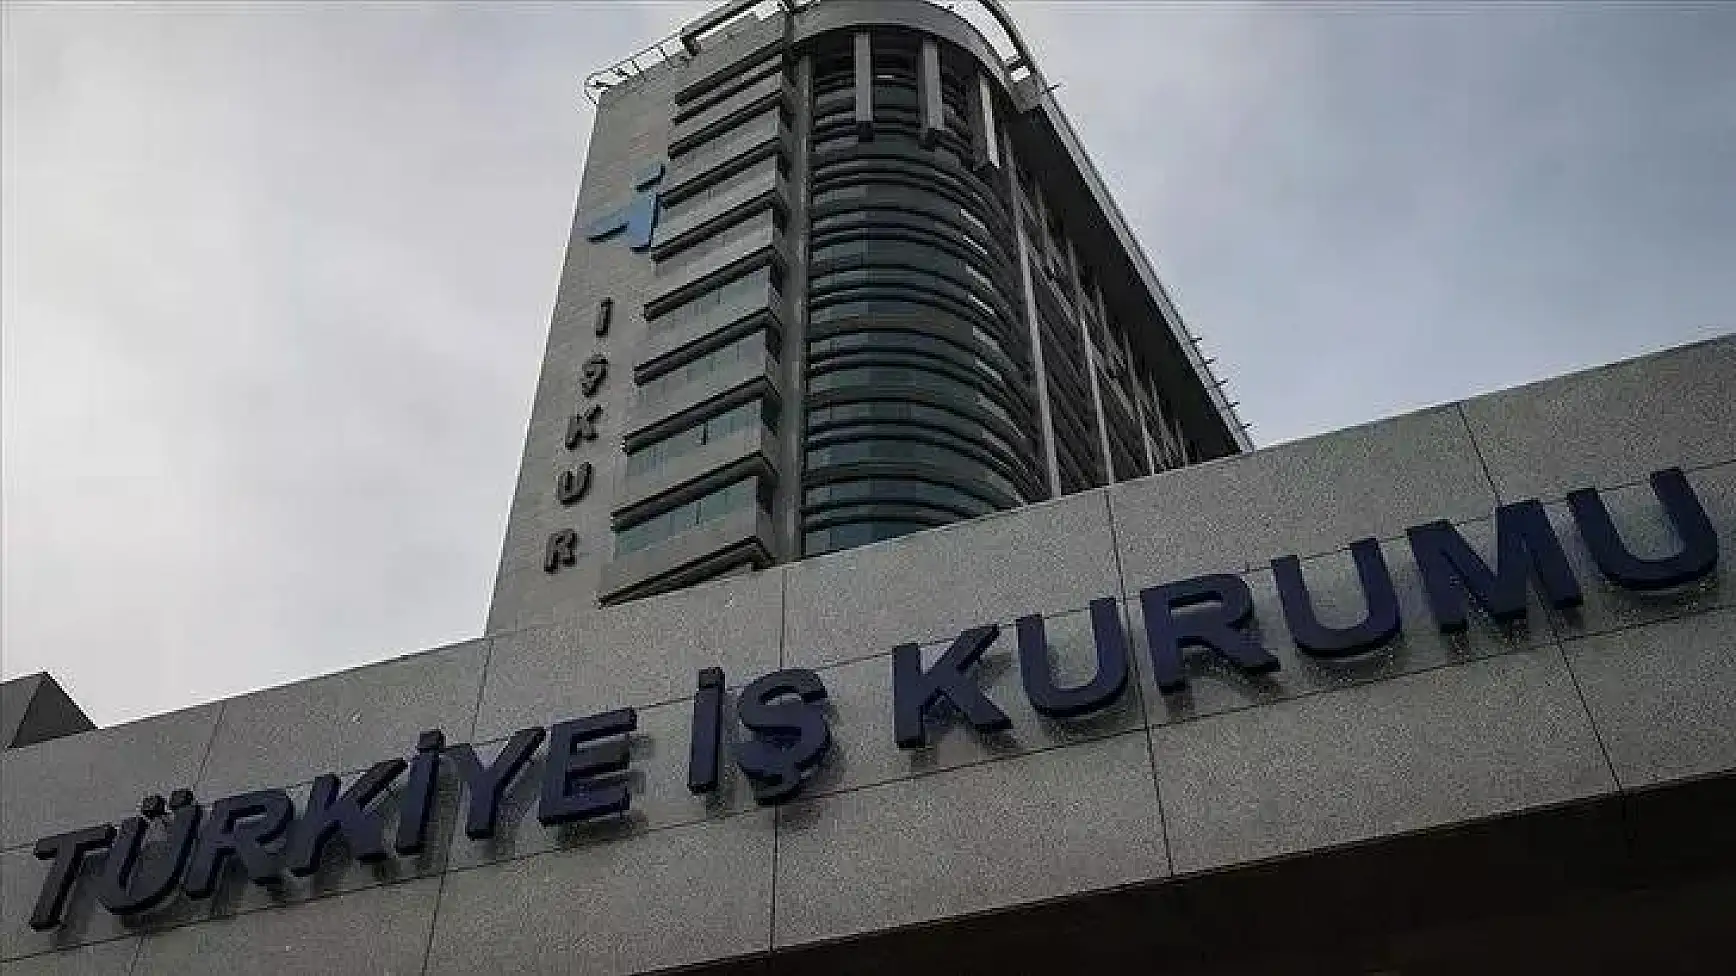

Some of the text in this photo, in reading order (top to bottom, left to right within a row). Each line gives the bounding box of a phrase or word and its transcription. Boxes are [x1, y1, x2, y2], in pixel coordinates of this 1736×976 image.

[30, 468, 1719, 931] TÜRKİYE İŞ KURUMU
